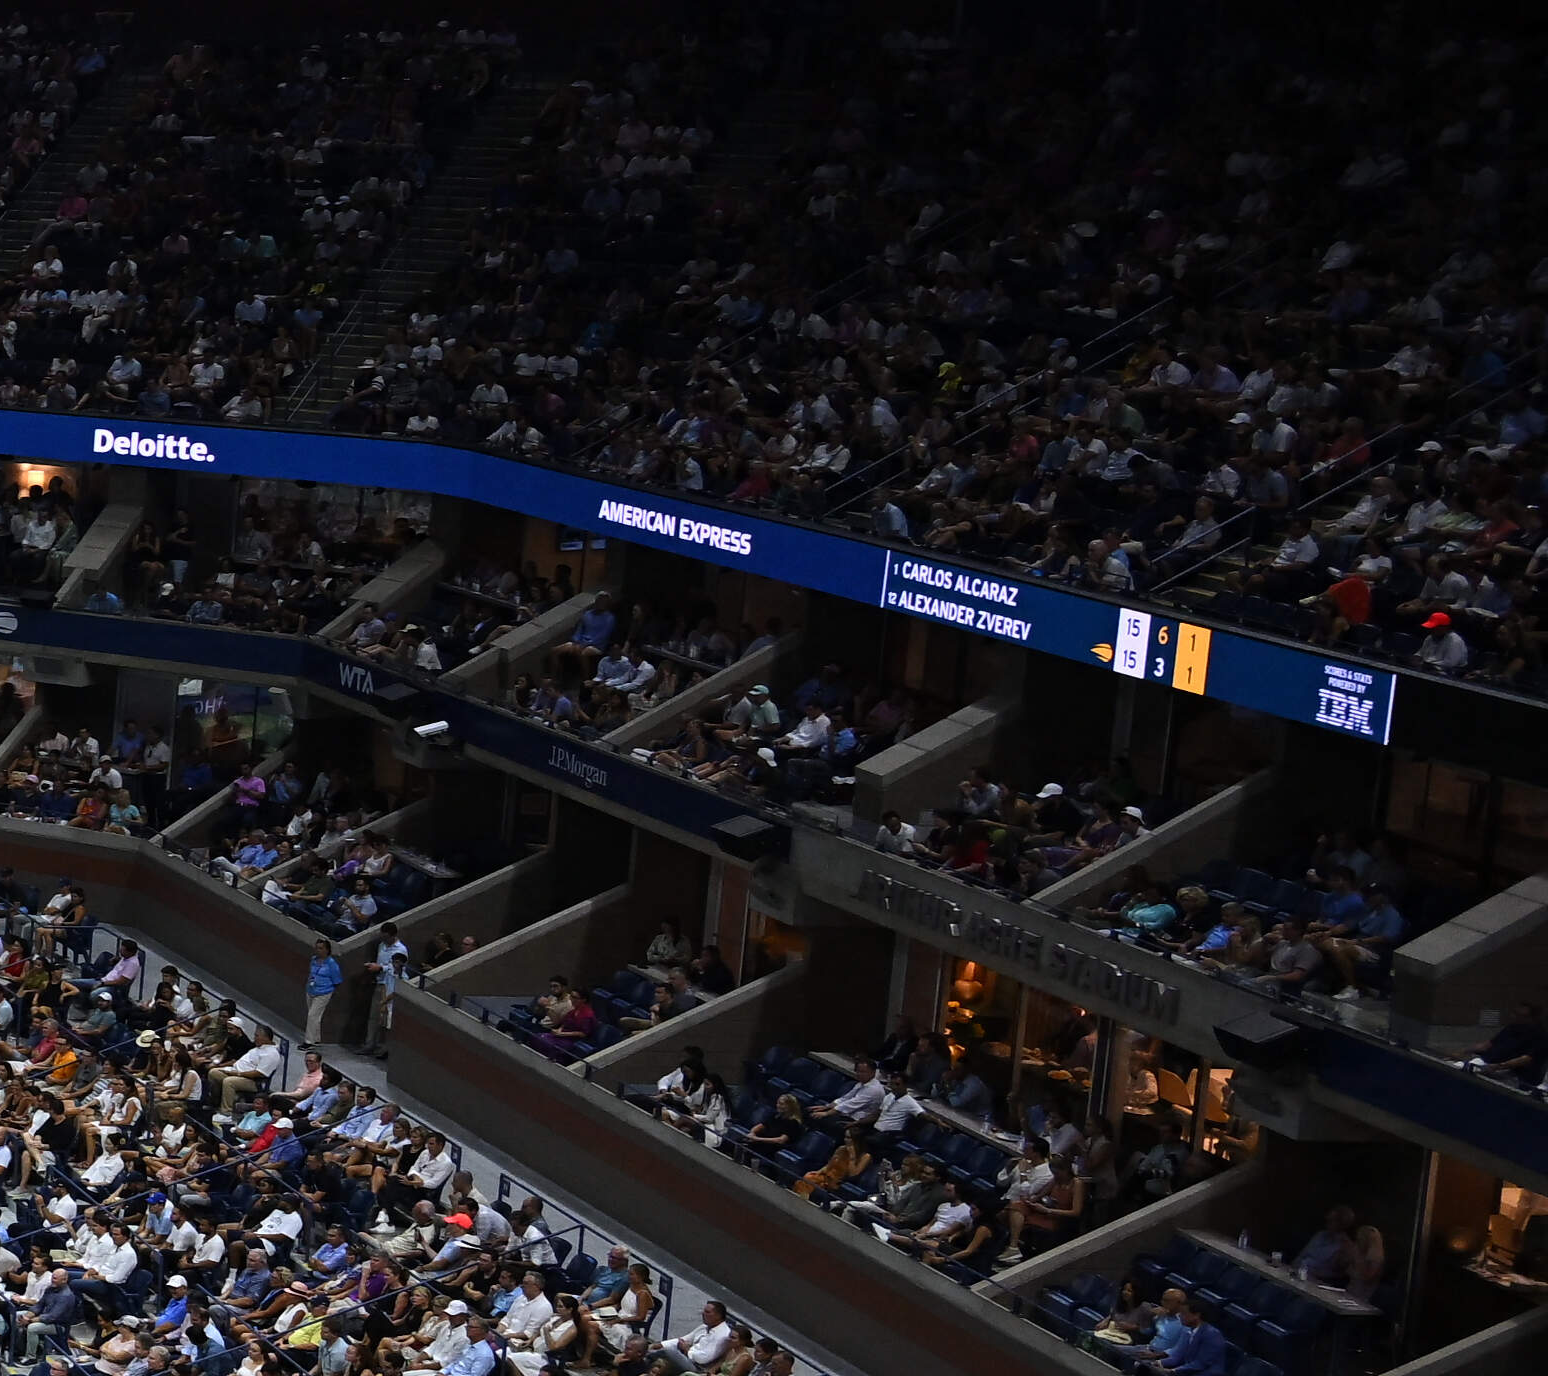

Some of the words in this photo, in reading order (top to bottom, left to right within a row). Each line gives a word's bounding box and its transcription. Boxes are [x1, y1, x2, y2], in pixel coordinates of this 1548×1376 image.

[93, 428, 215, 463] Deloitte.
[598, 499, 677, 537] AMERICAN
[678, 518, 752, 556] EXPRESS
[893, 564, 899, 576] 1
[901, 561, 953, 591] CARLOS
[953, 573, 1020, 607] ALCARAZ
[887, 591, 898, 605] 12
[898, 592, 975, 628] ALEXANDER
[975, 609, 1032, 642] ZVEREV
[1127, 618, 1141, 638] 15
[1157, 625, 1169, 645] 6
[1190, 633, 1197, 652] 1
[339, 661, 374, 694] WTA
[1123, 649, 1137, 669] 15
[1153, 657, 1165, 678] 3
[1187, 666, 1193, 685] 1
[1314, 687, 1374, 736] IBM
[548, 744, 608, 789] J.P.Morgan
